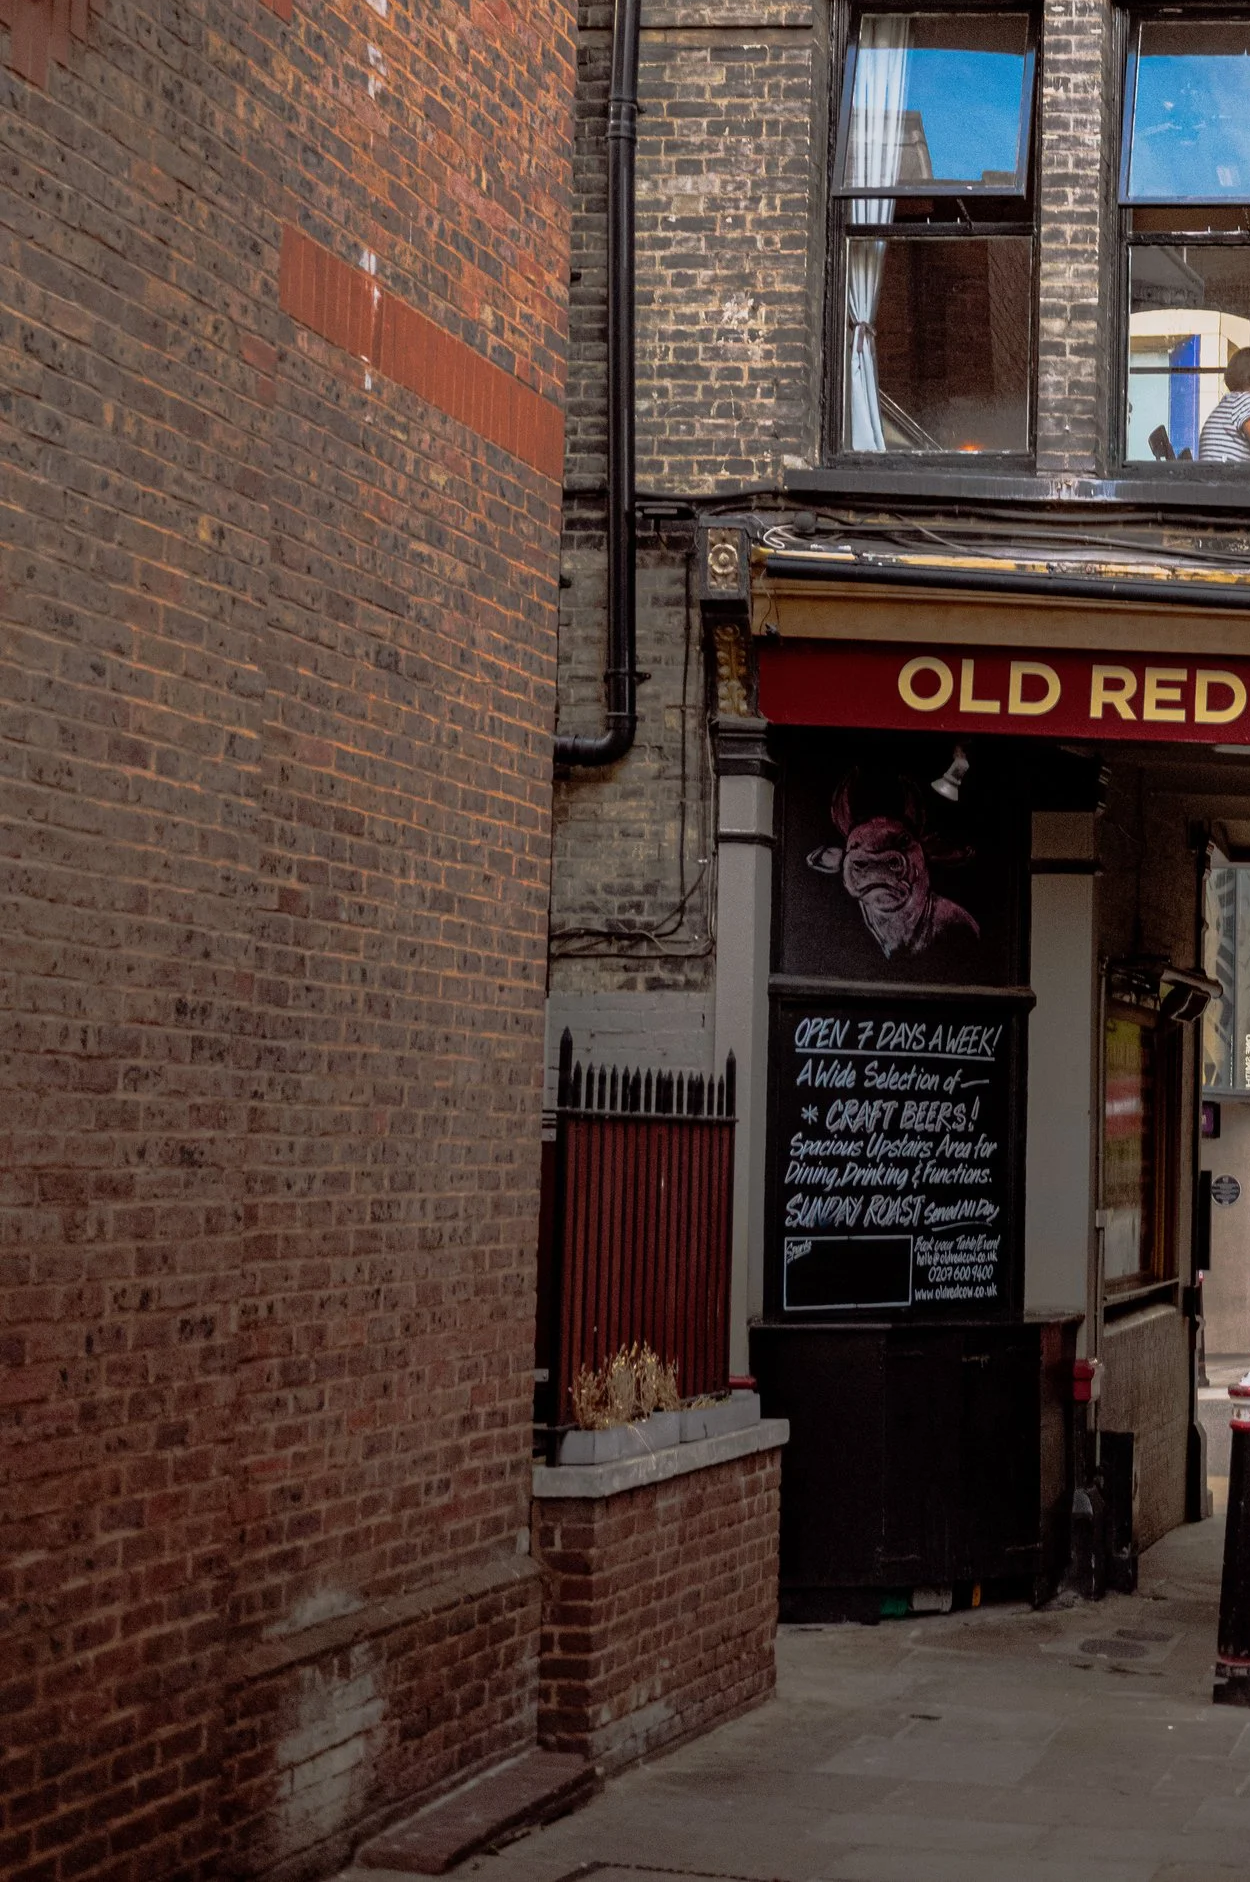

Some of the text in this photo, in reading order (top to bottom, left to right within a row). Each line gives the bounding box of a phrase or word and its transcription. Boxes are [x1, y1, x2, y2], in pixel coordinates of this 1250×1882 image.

[897, 655, 1062, 717] OLD
[1089, 664, 1249, 725] RED
[794, 1017, 1003, 1056] OPEN 7 DAYS A WEEK!
[796, 1058, 964, 1095] A Wide Selection of
[825, 1095, 980, 1133] CRAFT BEERS!
[790, 1131, 999, 1163] Spacious Upstairs Area for
[911, 1160, 924, 1189] &
[922, 1159, 993, 1185] Functions.
[784, 1192, 864, 1228] SUNDAY
[863, 1194, 926, 1228] ROAST
[959, 1198, 977, 1219] All
[975, 1197, 1000, 1223] Day
[786, 1239, 813, 1259] Sports
[914, 1235, 935, 1252] Book
[934, 1238, 954, 1252] your
[928, 1264, 994, 1283] 0207 600 9400
